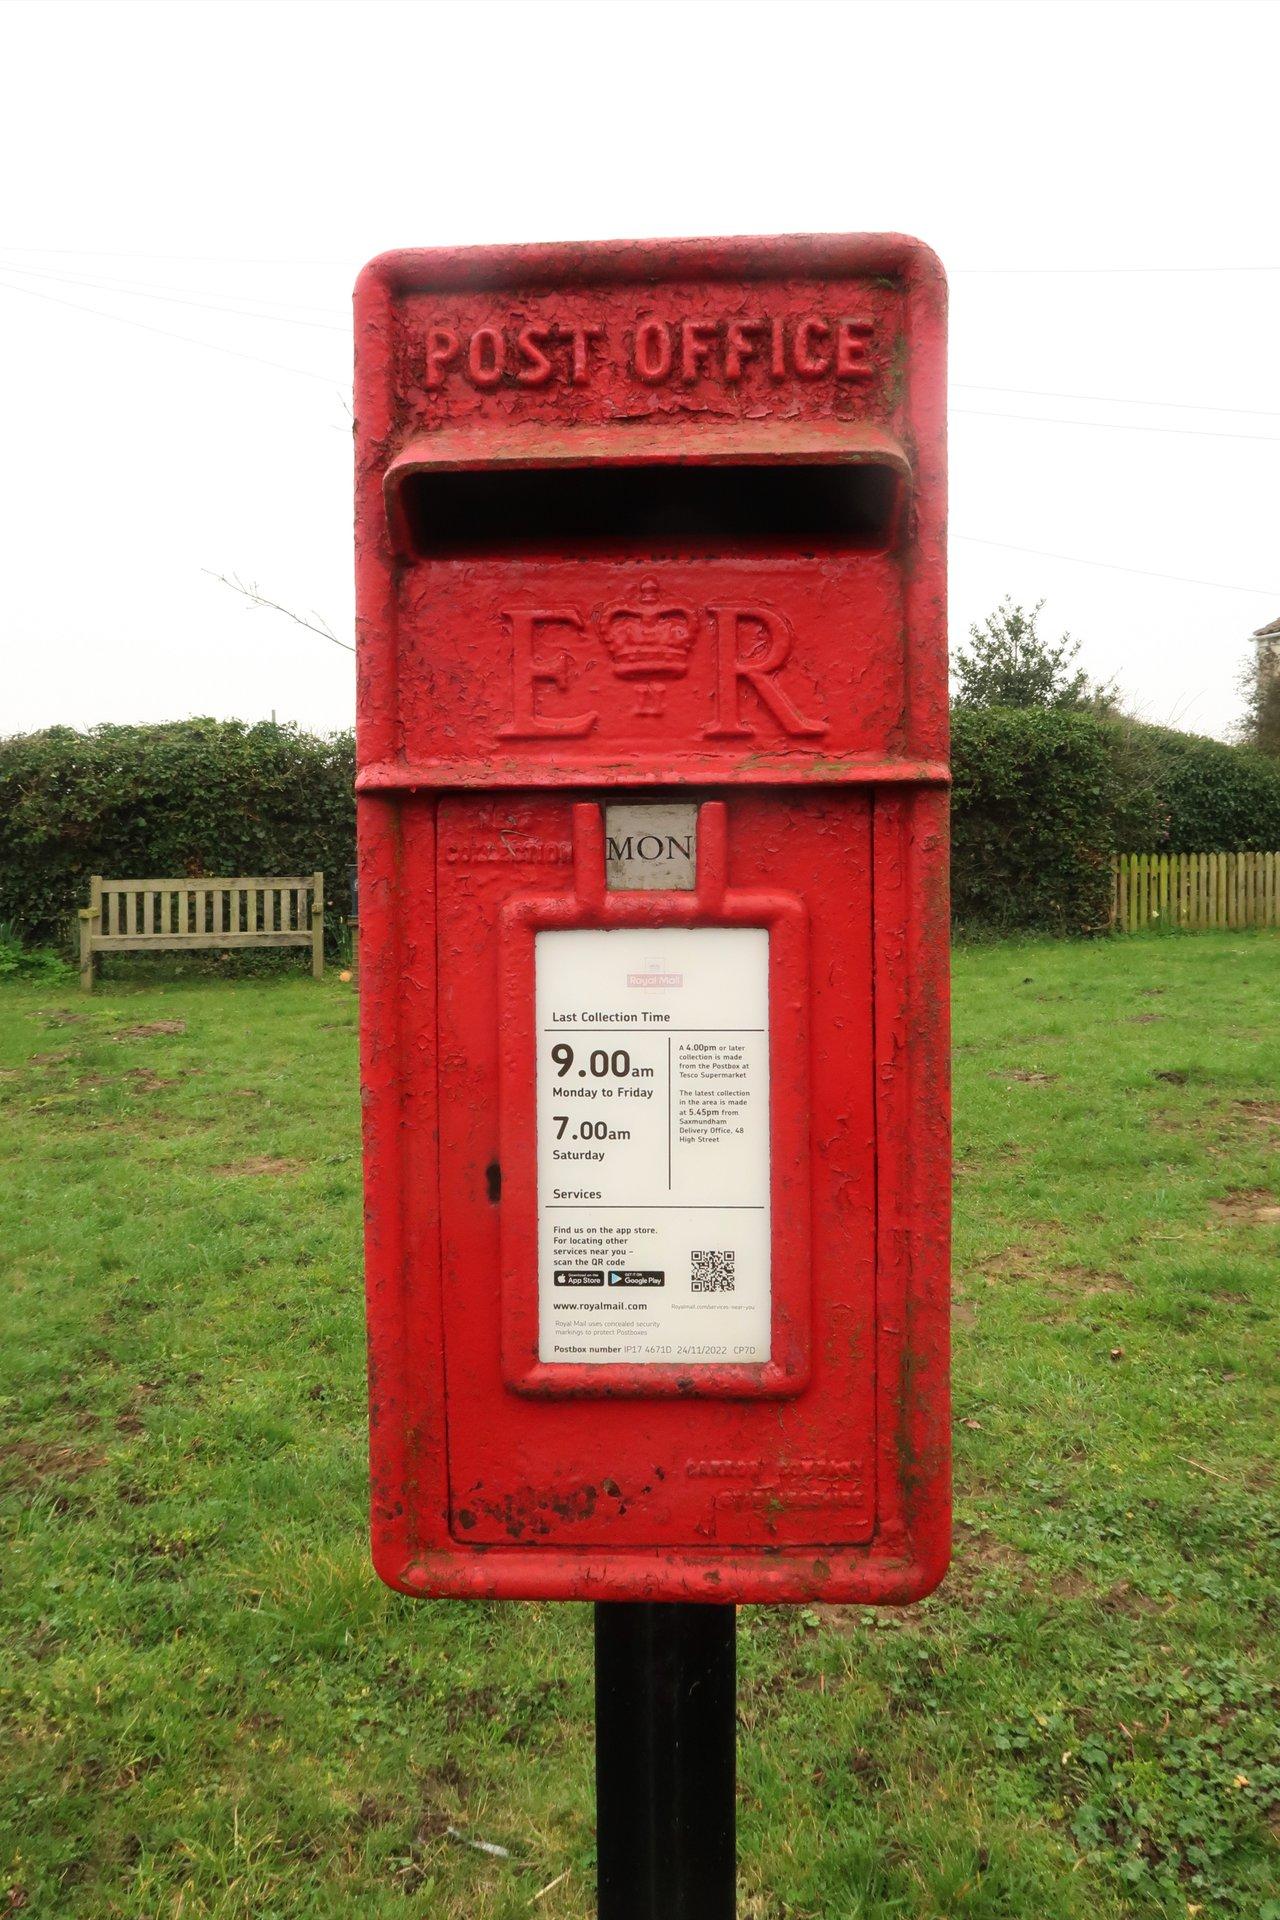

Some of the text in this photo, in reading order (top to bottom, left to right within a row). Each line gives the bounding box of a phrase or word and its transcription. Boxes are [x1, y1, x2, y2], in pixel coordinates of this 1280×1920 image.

[424, 317, 877, 390] POST OFFICE
[501, 604, 600, 740] E
[702, 604, 831, 740] R
[605, 835, 693, 861] MON
[630, 975, 680, 986] Royal Mail
[553, 1012, 670, 1022] Last Collection Time
[686, 1043, 716, 1052] 4.00pm
[551, 1044, 653, 1077] 9.00am
[700, 1071, 746, 1080] Supermarket
[553, 1087, 653, 1099] Monday to Friday
[688, 1108, 720, 1118] 5.45pm
[722, 1108, 740, 1116] from
[553, 1116, 630, 1140] 7.00am
[680, 1126, 708, 1134] Delivery
[710, 1126, 732, 1136] Office,
[680, 1135, 696, 1144] High
[553, 1150, 605, 1162] Saturday
[554, 1189, 601, 1199] Services
[554, 1225, 572, 1234] Find
[616, 1227, 632, 1236] app
[634, 1226, 658, 1234] store.
[554, 1236, 628, 1246] For locating other
[554, 1247, 588, 1256] services
[592, 1257, 604, 1266] QR
[568, 1276, 601, 1285] App Store
[624, 1277, 662, 1286] Google Play
[552, 1301, 648, 1312] www.royalmail.com
[554, 1319, 574, 1328] Royal
[604, 1319, 634, 1328] concealed
[636, 1319, 660, 1330] security
[554, 1328, 584, 1336] markings
[592, 1328, 616, 1336] protect
[554, 1344, 586, 1354] Postbox
[588, 1345, 622, 1354] number
[624, 1345, 642, 1354] IP17
[676, 1345, 728, 1356] 24/11/2022
